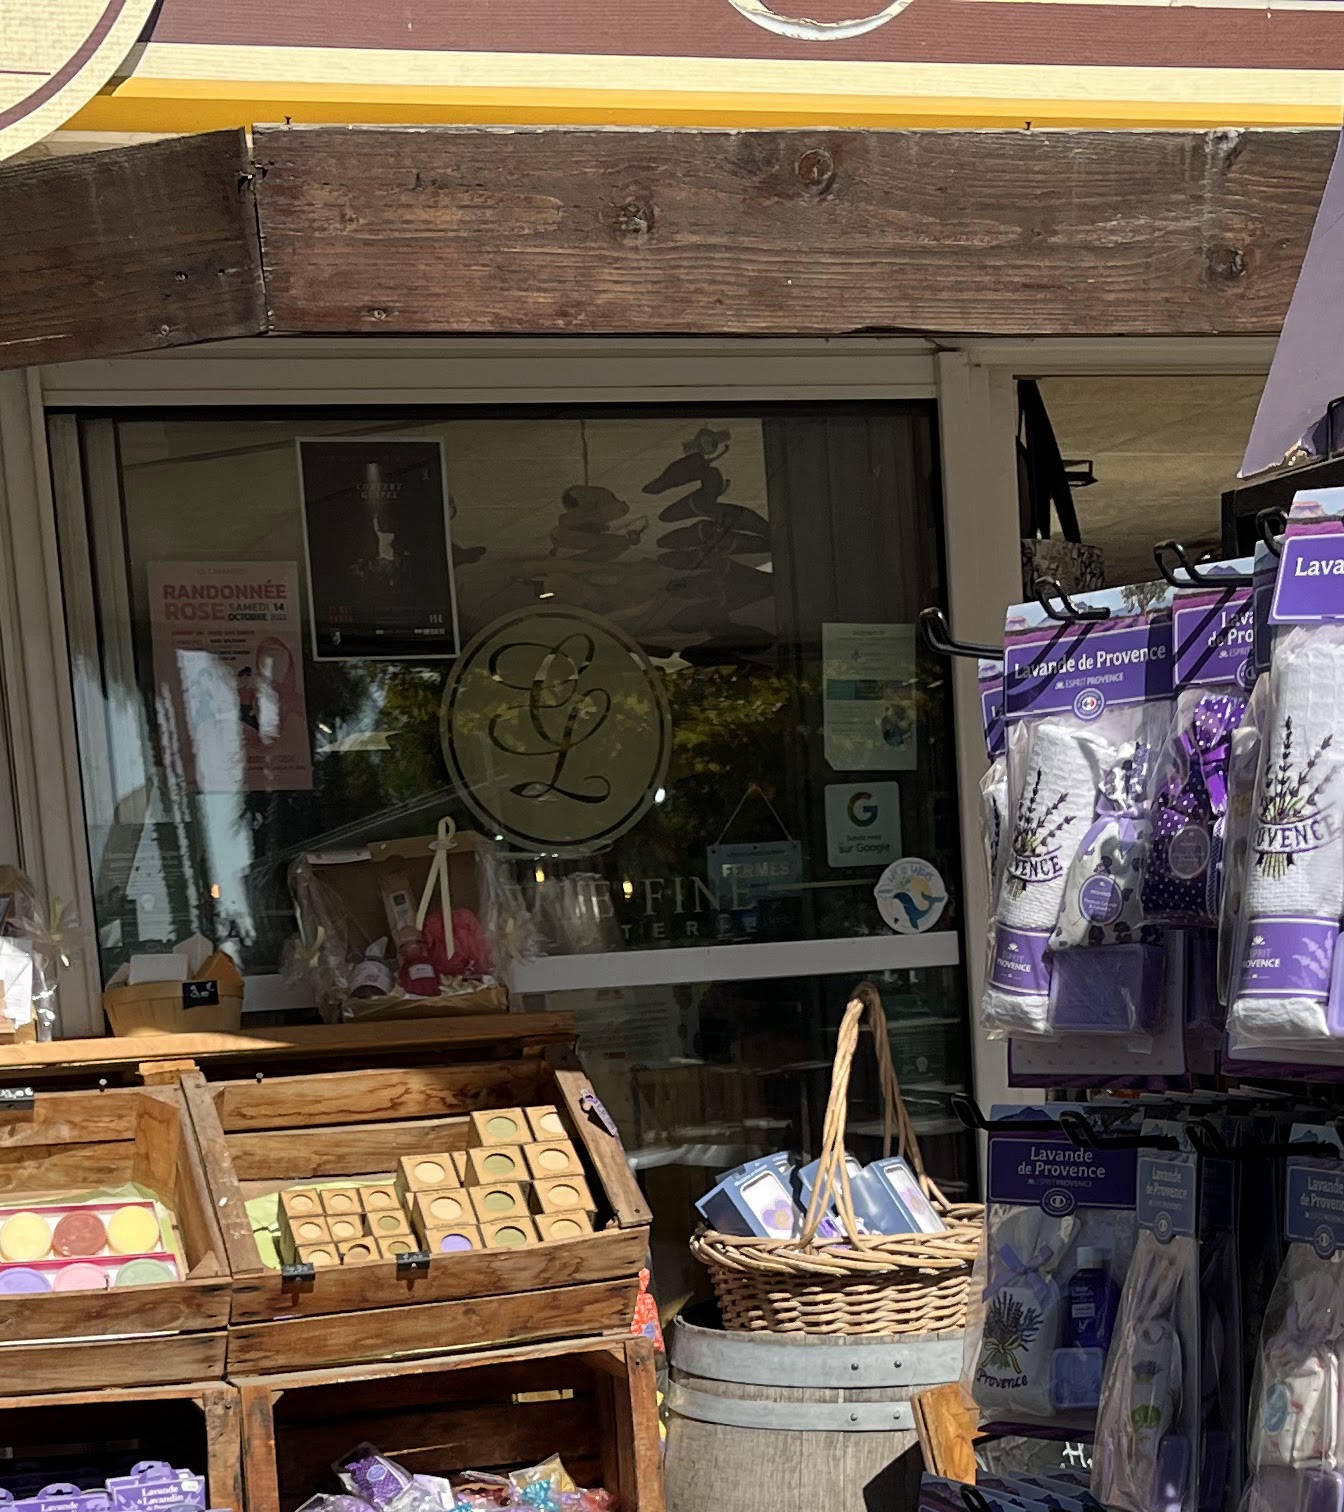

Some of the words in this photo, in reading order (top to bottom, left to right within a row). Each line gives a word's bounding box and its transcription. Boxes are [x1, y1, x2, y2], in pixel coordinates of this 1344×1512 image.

[162, 578, 288, 601] RANDONNÉE
[164, 602, 226, 621] ROSE
[1014, 656, 1075, 680] Lavande
[1078, 653, 1094, 672] de
[1096, 644, 1166, 669] Provence
[856, 842, 891, 854] Google
[1030, 1146, 1094, 1163] Lavande
[1018, 1162, 1033, 1175] de
[1034, 1162, 1106, 1179] Provence
[1307, 1175, 1344, 1195] Lavande
